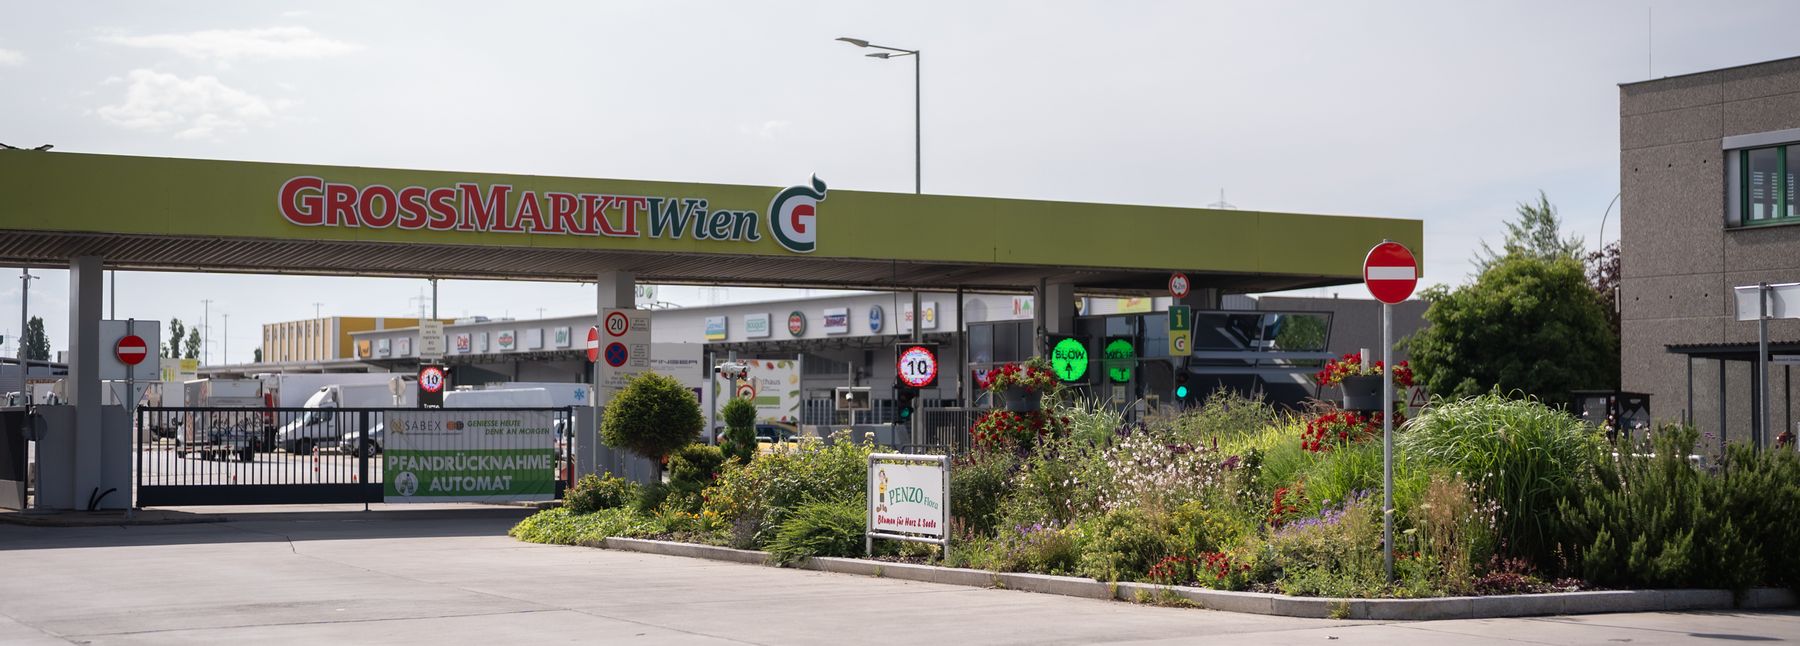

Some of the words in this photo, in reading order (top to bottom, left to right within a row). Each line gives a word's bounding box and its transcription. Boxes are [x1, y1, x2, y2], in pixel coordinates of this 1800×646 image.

[611, 318, 623, 330] 20
[908, 360, 927, 375] 10
[427, 375, 439, 385] 10
[405, 421, 441, 431] SABEX
[388, 453, 550, 471] PFANDRÜCKNAHME
[429, 476, 512, 492] AUTOMAT
[888, 487, 924, 505] PENZO
